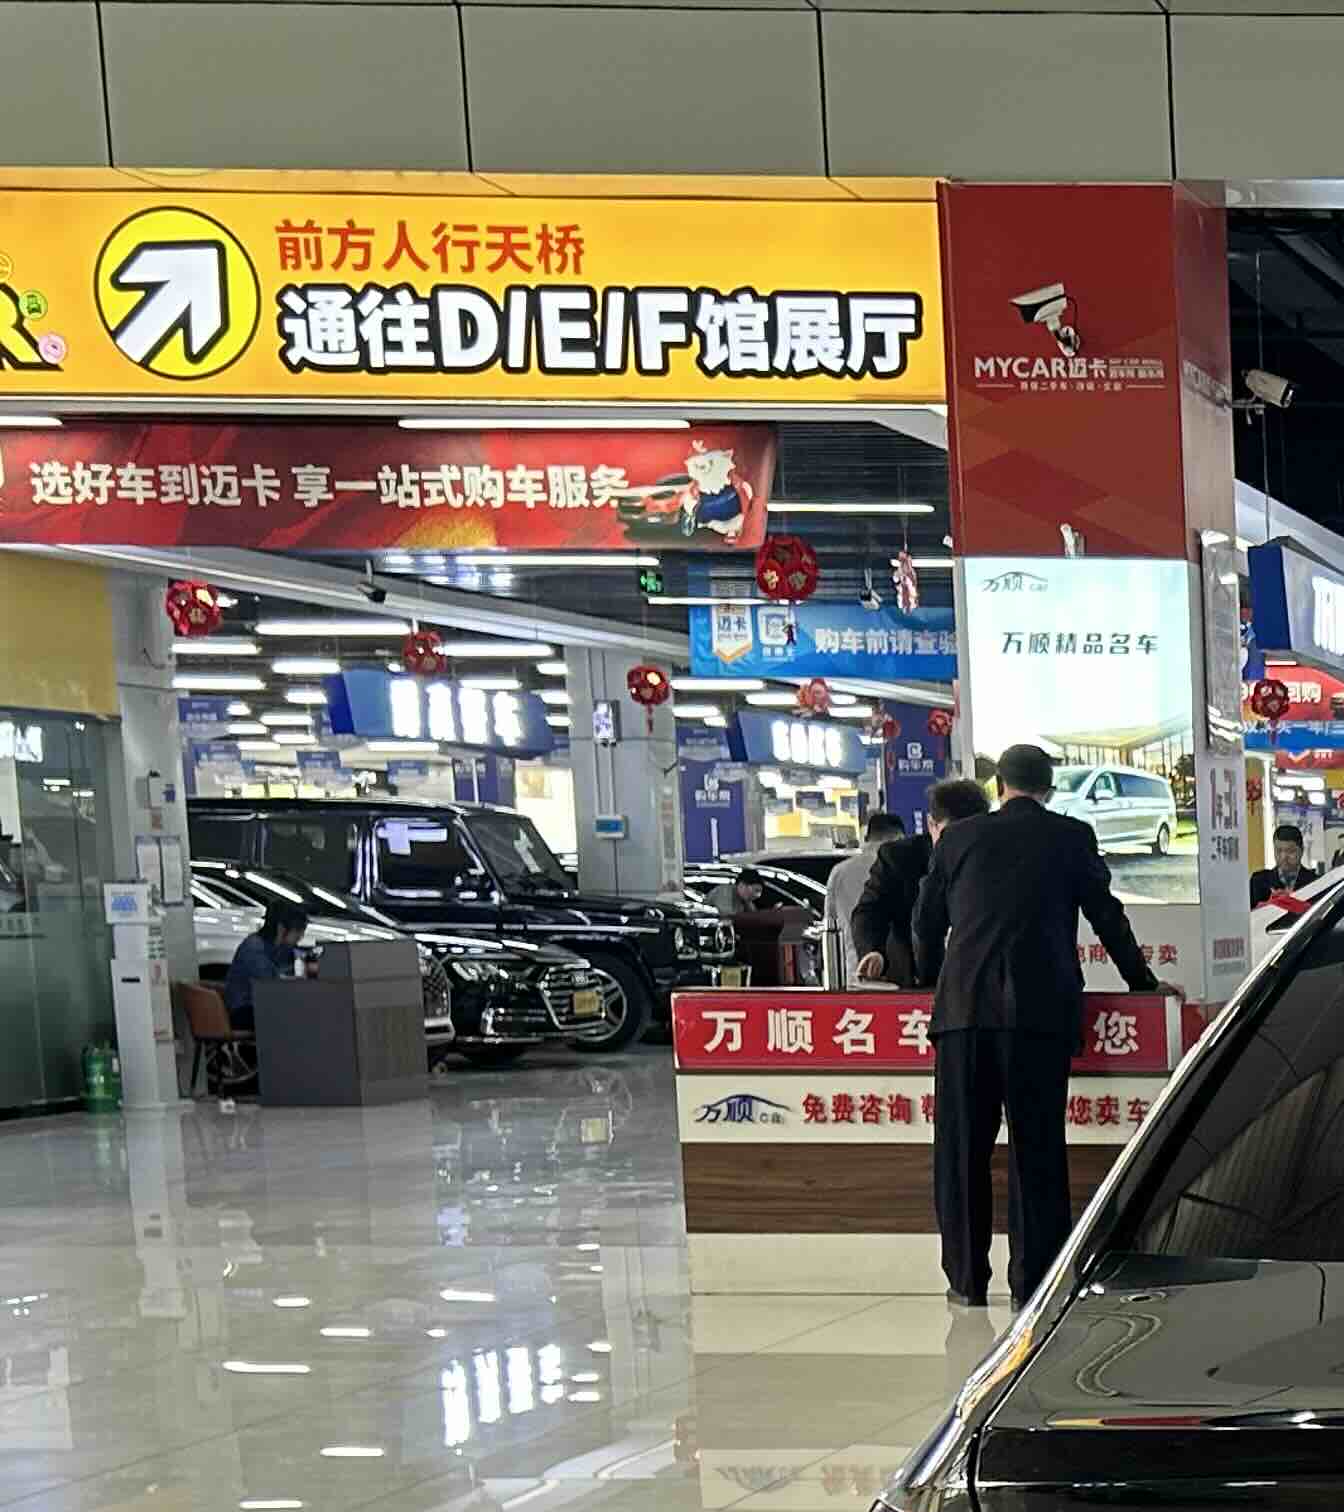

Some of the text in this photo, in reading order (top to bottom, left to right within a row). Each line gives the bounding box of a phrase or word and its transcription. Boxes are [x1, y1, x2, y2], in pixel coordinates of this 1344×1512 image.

[275, 219, 585, 275] 前方人行天桥
[30, 462, 630, 508] 选好车到迈卡 享一站式购车服务
[1000, 631, 1160, 655] 万顺精品名车
[701, 1008, 1139, 1056] 万顺名车 您
[802, 1092, 913, 1125] 免费咨询
[1066, 1095, 1150, 1126] 您卖车
